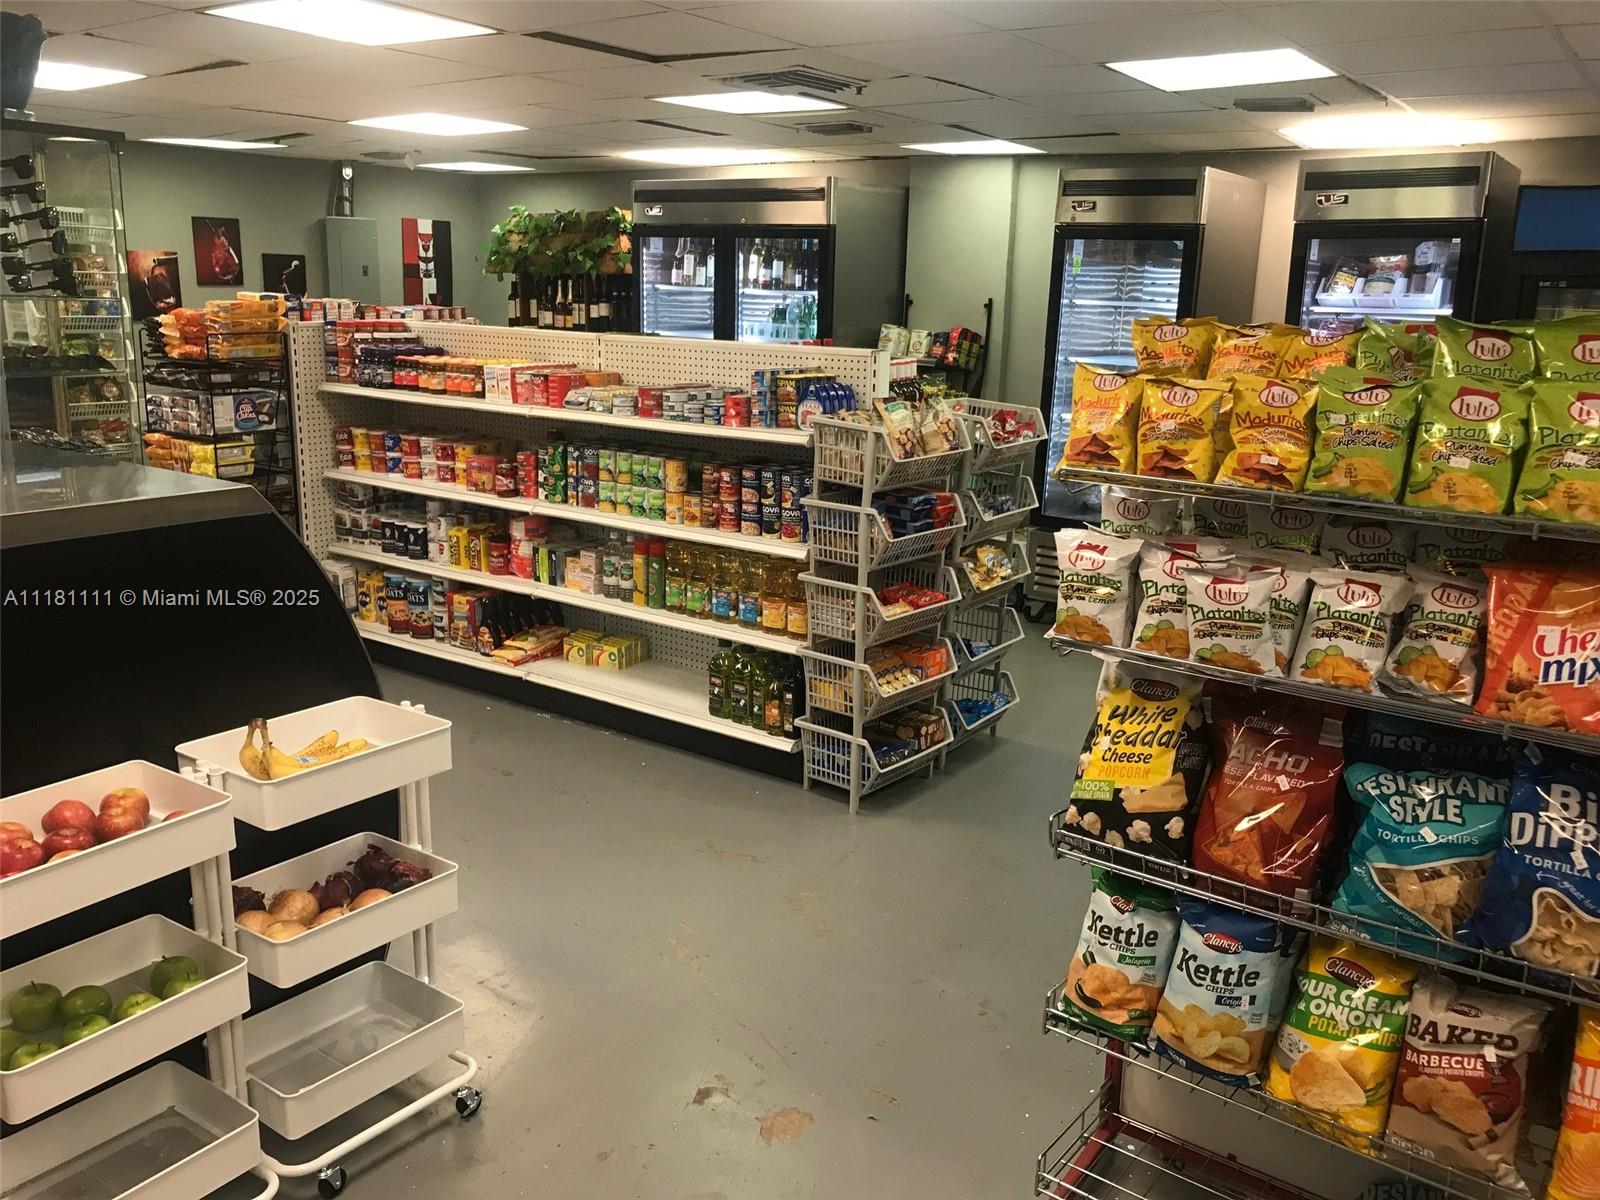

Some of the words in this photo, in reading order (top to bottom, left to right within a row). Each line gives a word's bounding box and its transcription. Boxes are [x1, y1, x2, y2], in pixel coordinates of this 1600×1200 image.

[776, 379, 796, 387] SPAM
[777, 405, 796, 414] SPAM
[1131, 680, 1179, 700] Clancy's
[1107, 703, 1180, 726] White
[1101, 747, 1153, 765] Cheese
[1097, 765, 1152, 779] POPCORN
[1388, 796, 1463, 824] STYLE
[1376, 826, 1432, 843] TORTILL
[1086, 908, 1159, 948] Kettle
[1109, 943, 1136, 955] CHIPS
[1202, 932, 1244, 953] Clancy's
[1177, 946, 1261, 988] Kettle
[1205, 984, 1235, 995] CHIPS
[1309, 998, 1383, 1030] ONION
[1308, 1016, 1361, 1038] POTATO
[1407, 1013, 1520, 1052] BAKED
[1405, 1048, 1485, 1071] BARBECUE
